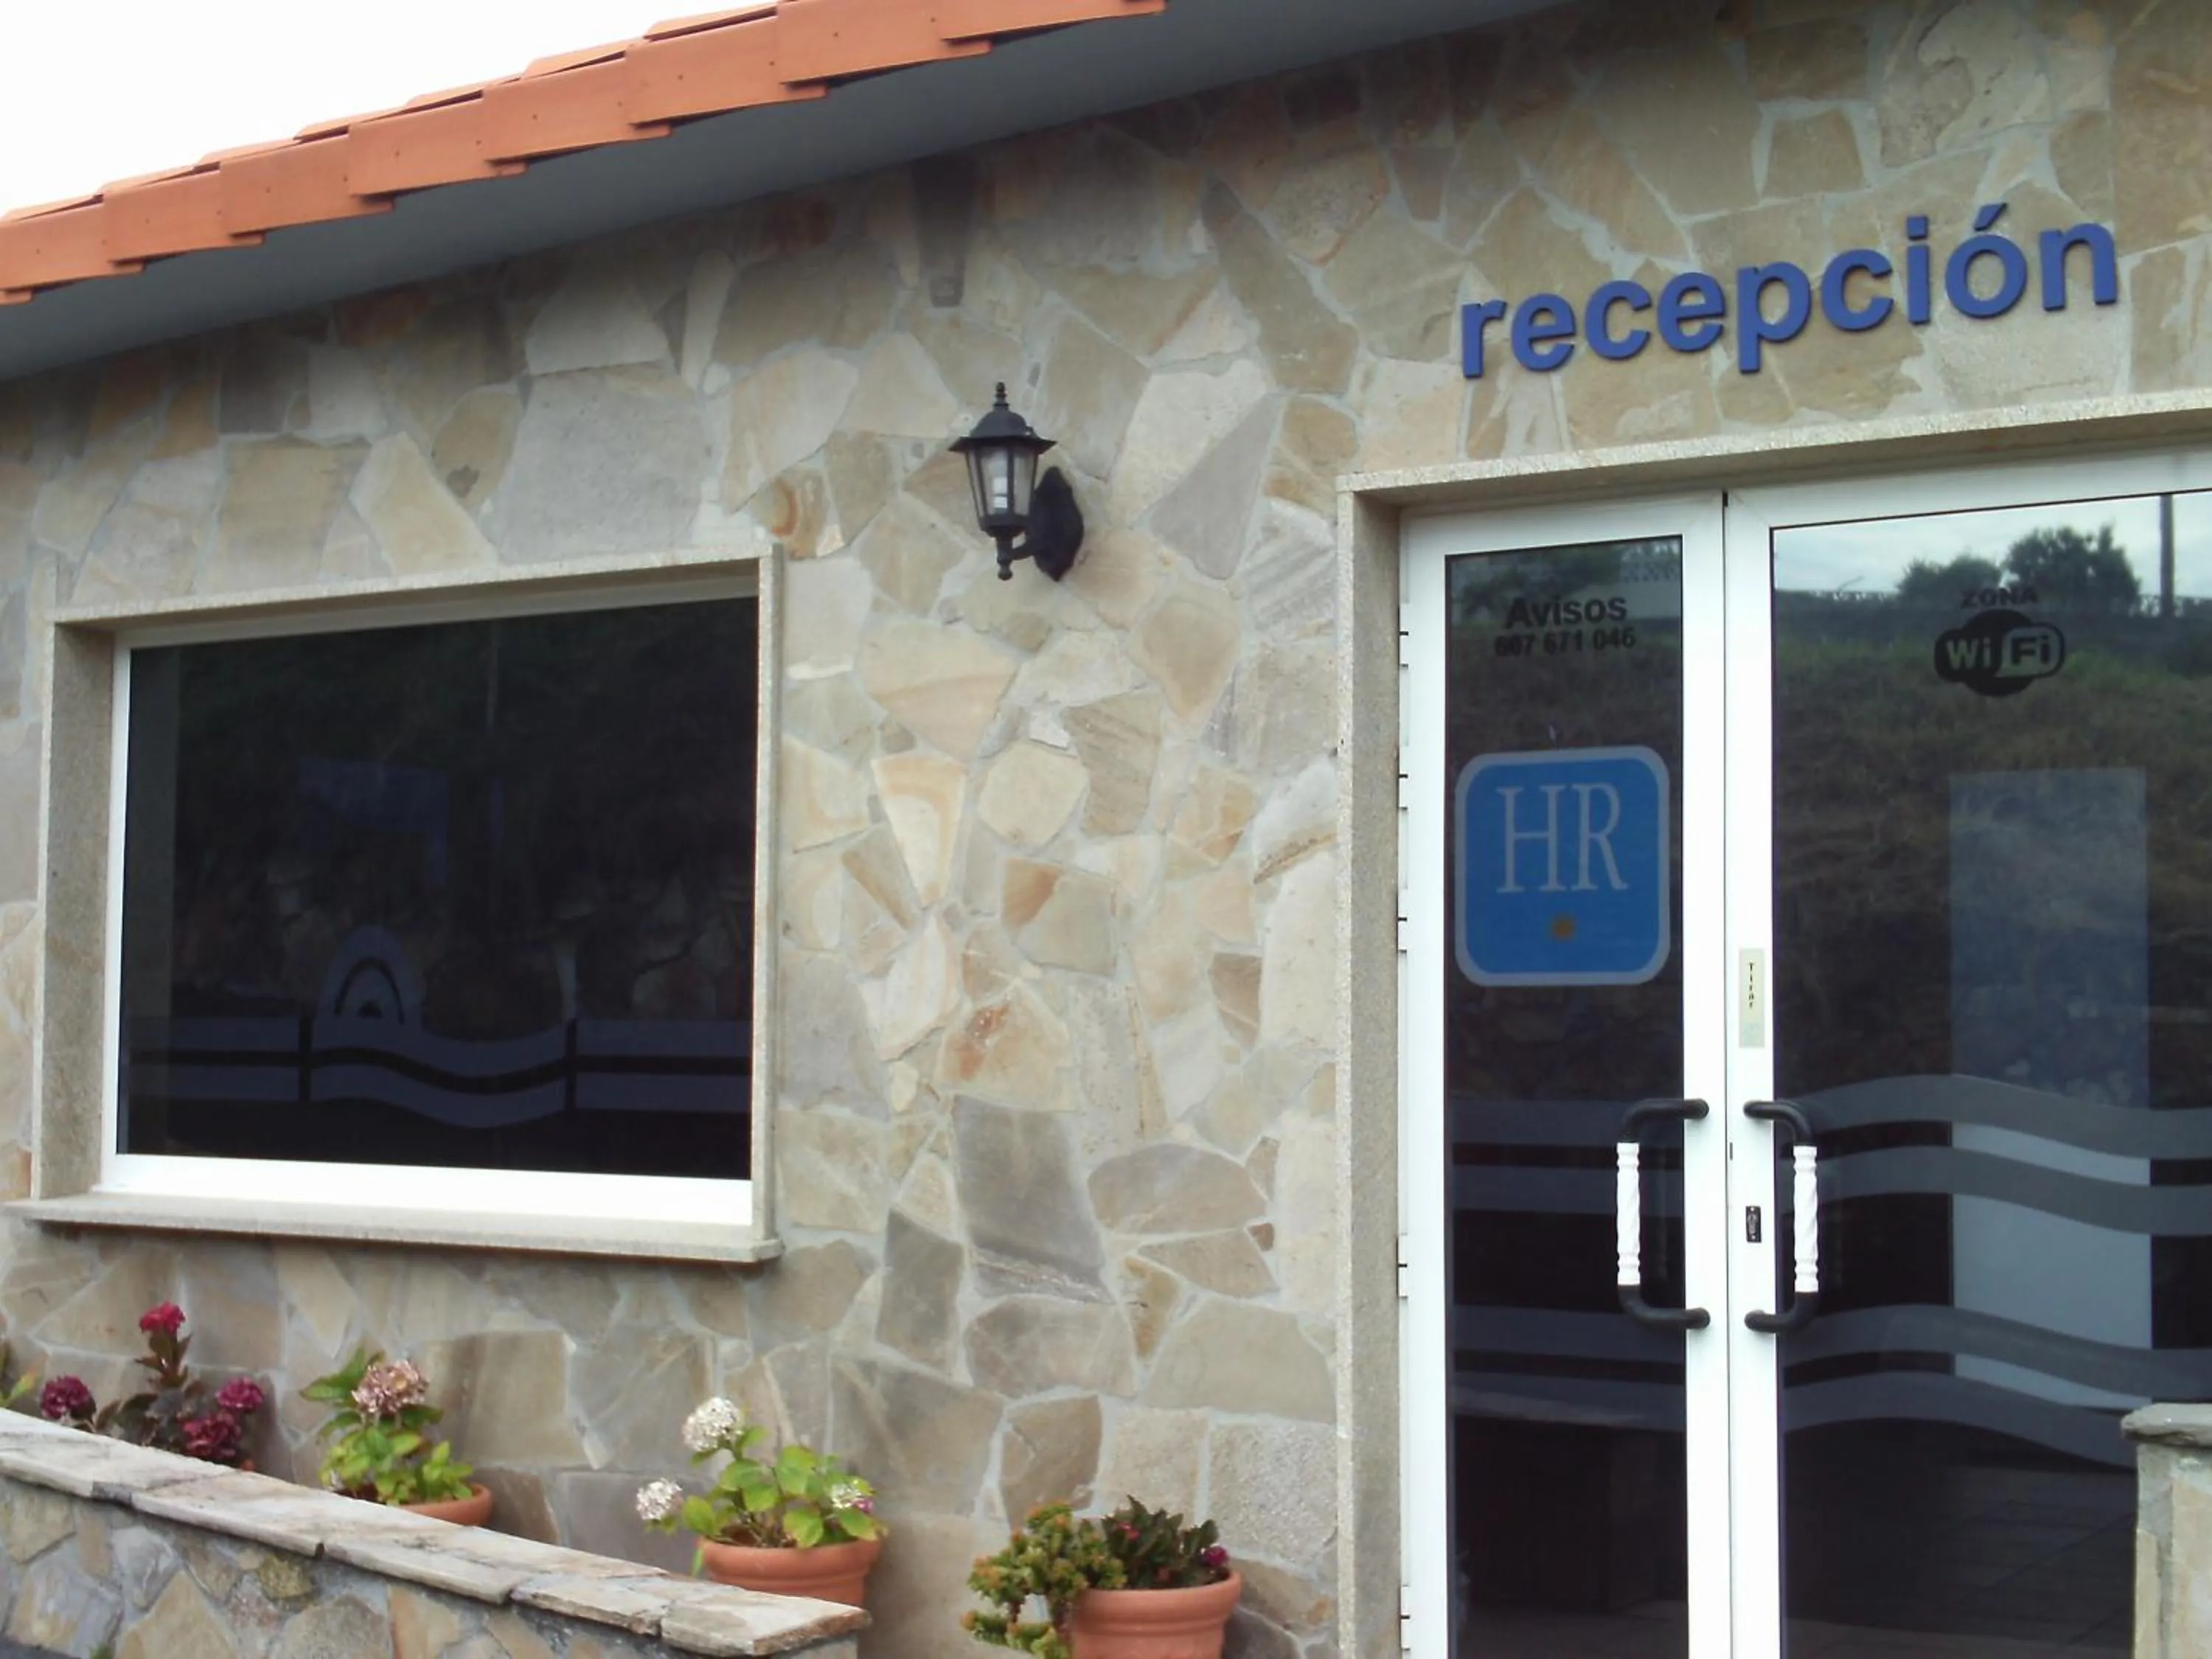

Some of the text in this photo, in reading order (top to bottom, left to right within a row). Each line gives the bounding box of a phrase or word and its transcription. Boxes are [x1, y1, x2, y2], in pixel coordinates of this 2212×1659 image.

[1461, 202, 2117, 379] recepción
[1506, 595, 1627, 628] Avisos
[1960, 588, 2039, 608] ZONA
[1496, 782, 1629, 894] HR
